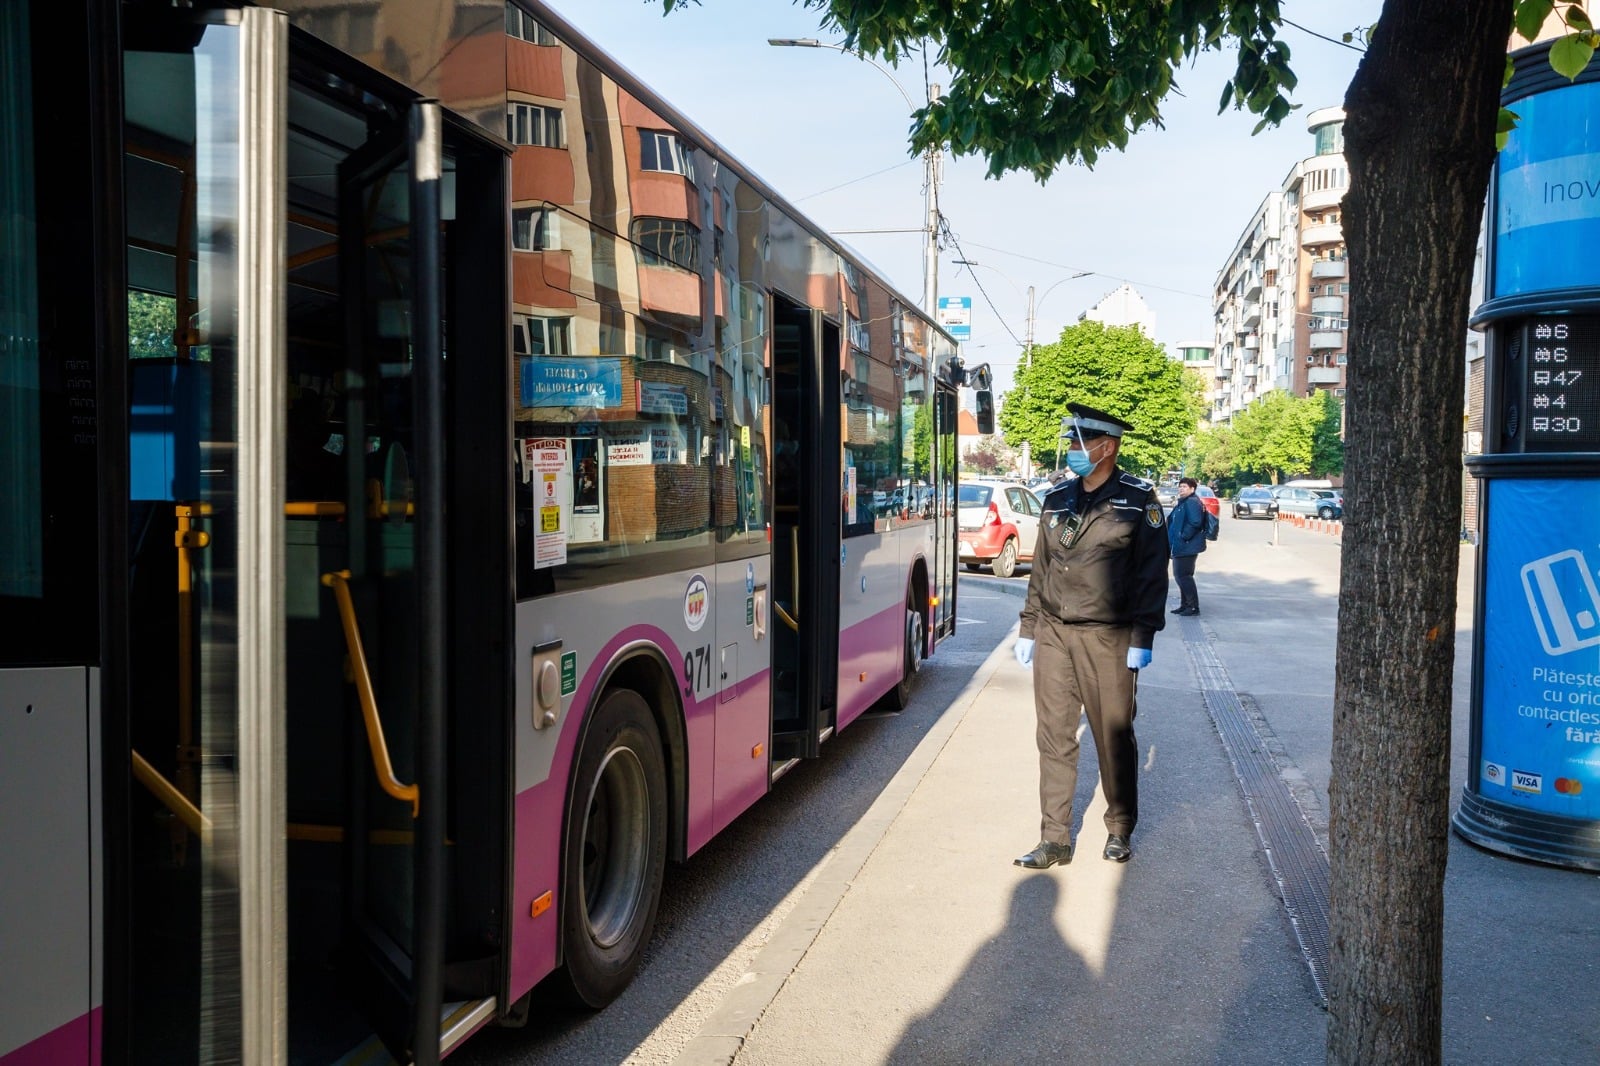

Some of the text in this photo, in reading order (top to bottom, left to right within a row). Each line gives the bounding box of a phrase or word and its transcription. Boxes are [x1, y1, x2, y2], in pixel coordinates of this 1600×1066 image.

[1544, 180, 1600, 204] Inov
[1554, 324, 1568, 339] 6
[1553, 347, 1568, 362] 6
[1553, 370, 1582, 386] 47
[1552, 394, 1566, 409] 4
[1551, 417, 1580, 432] 30
[684, 643, 711, 698] 971
[1543, 689, 1600, 705] cu oric
[1518, 704, 1600, 725] contactles
[1516, 775, 1538, 788] VISA
